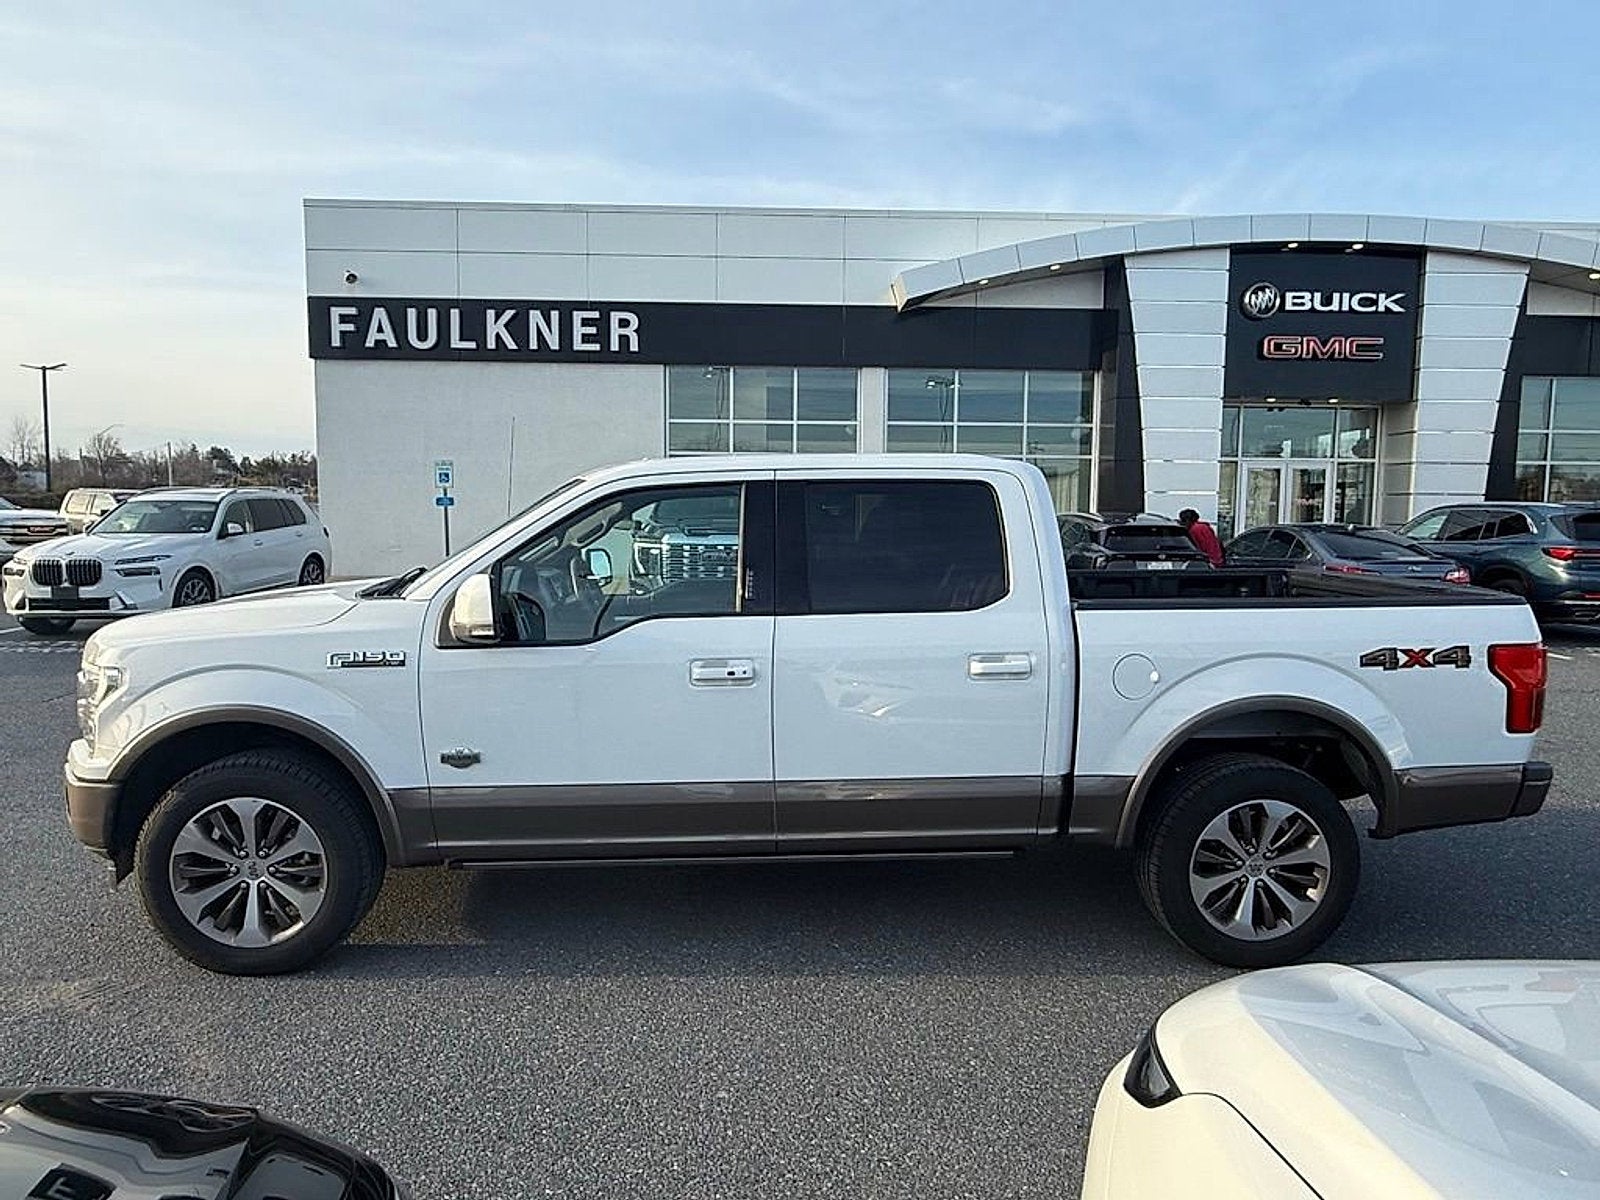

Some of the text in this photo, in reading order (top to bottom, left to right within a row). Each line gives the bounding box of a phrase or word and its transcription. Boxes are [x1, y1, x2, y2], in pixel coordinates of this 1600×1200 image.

[1284, 291, 1406, 312] BUICK
[329, 306, 640, 352] FAULKNER
[1263, 335, 1384, 359] GMC
